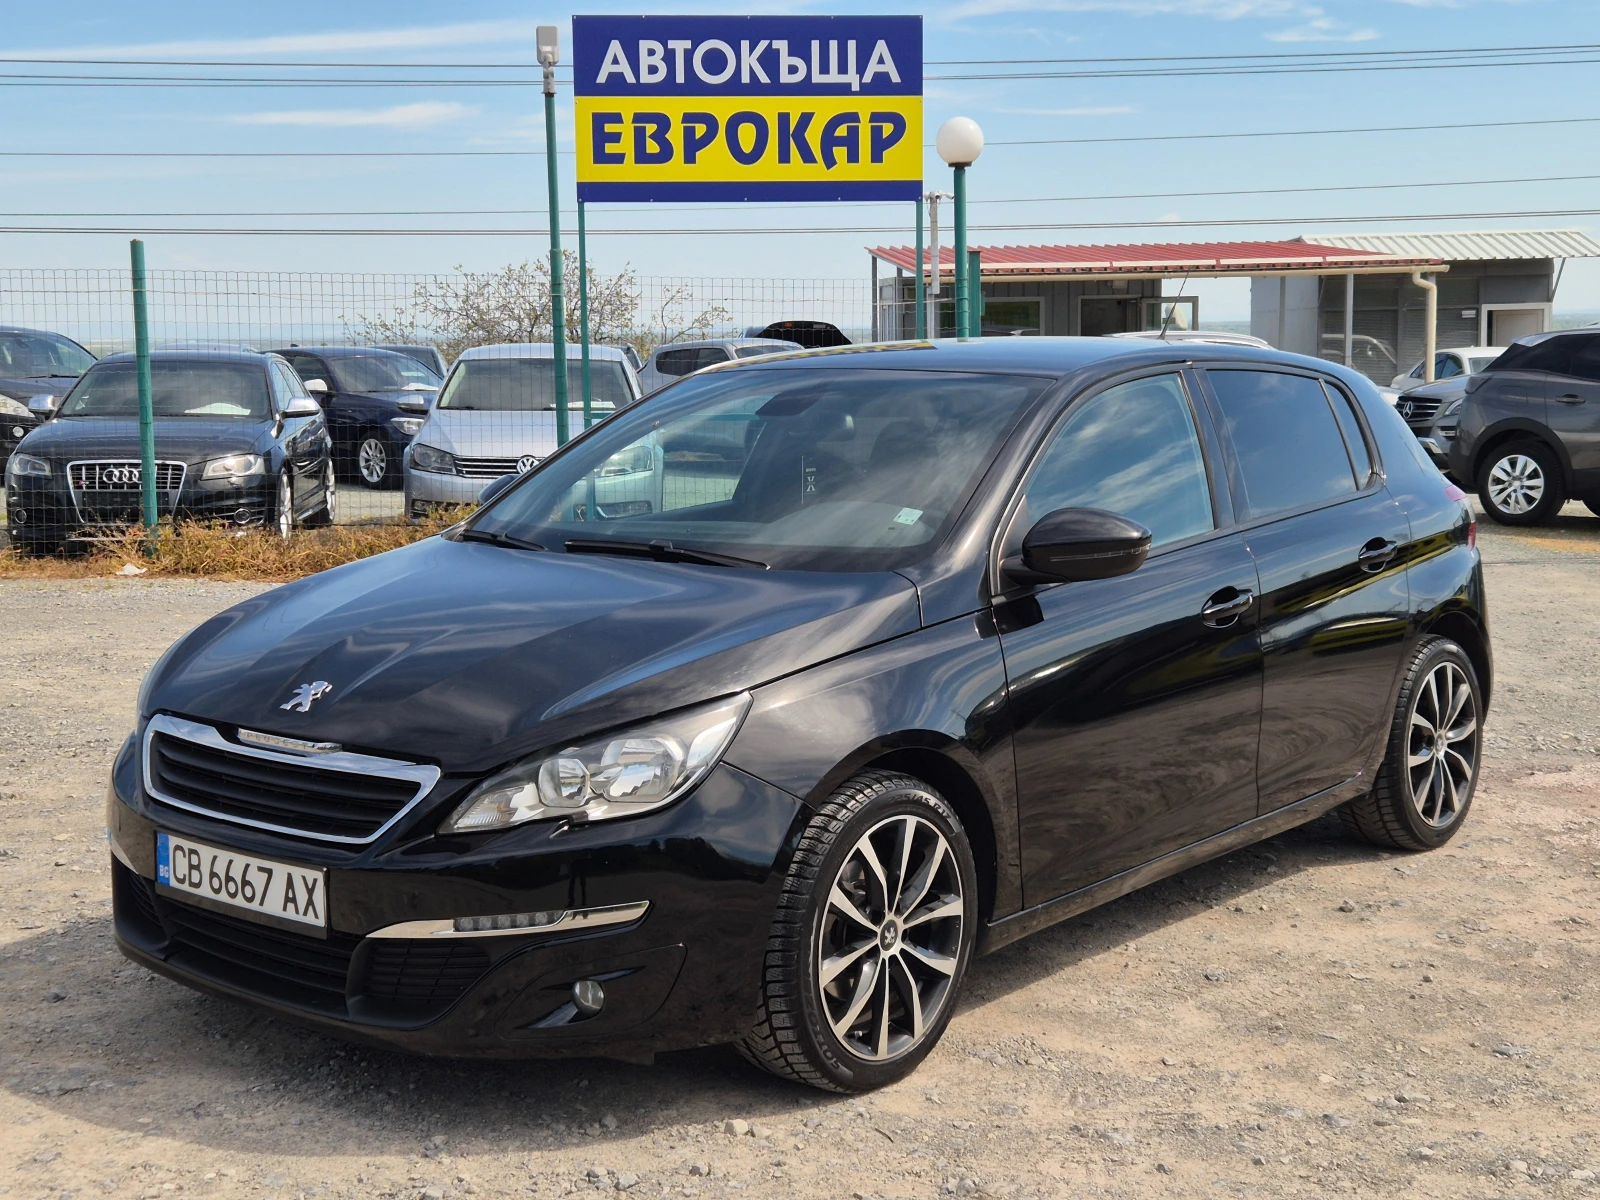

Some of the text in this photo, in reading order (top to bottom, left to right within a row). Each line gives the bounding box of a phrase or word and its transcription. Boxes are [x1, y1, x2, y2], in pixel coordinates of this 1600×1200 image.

[595, 39, 902, 92] АВТОКЪЩА
[591, 110, 907, 171] ЕВРОКАР
[172, 844, 319, 920] CB 6667 AX
